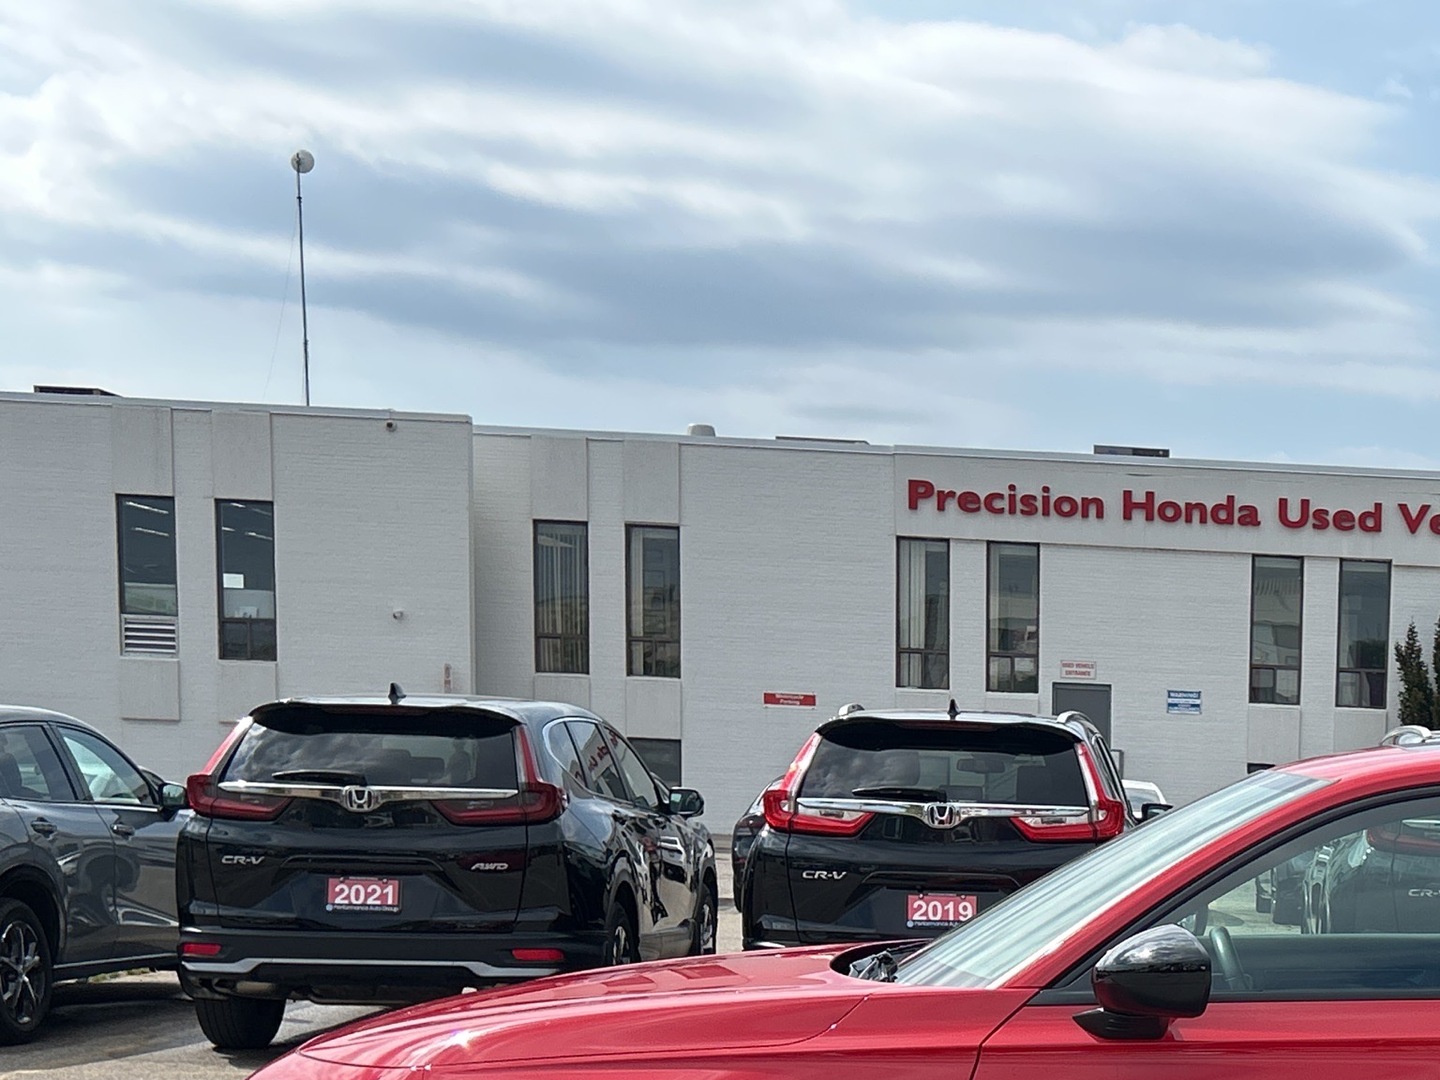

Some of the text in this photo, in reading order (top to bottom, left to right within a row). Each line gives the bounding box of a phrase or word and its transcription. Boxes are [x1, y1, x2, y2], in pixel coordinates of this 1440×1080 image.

[908, 479, 1104, 519] Precision
[1122, 490, 1261, 526] Honda
[1278, 498, 1383, 533] Used
[221, 855, 265, 865] CR-V
[470, 862, 509, 870] AWD
[802, 870, 847, 880] CR-V
[334, 883, 394, 905] 2021
[912, 901, 973, 921] 2019
